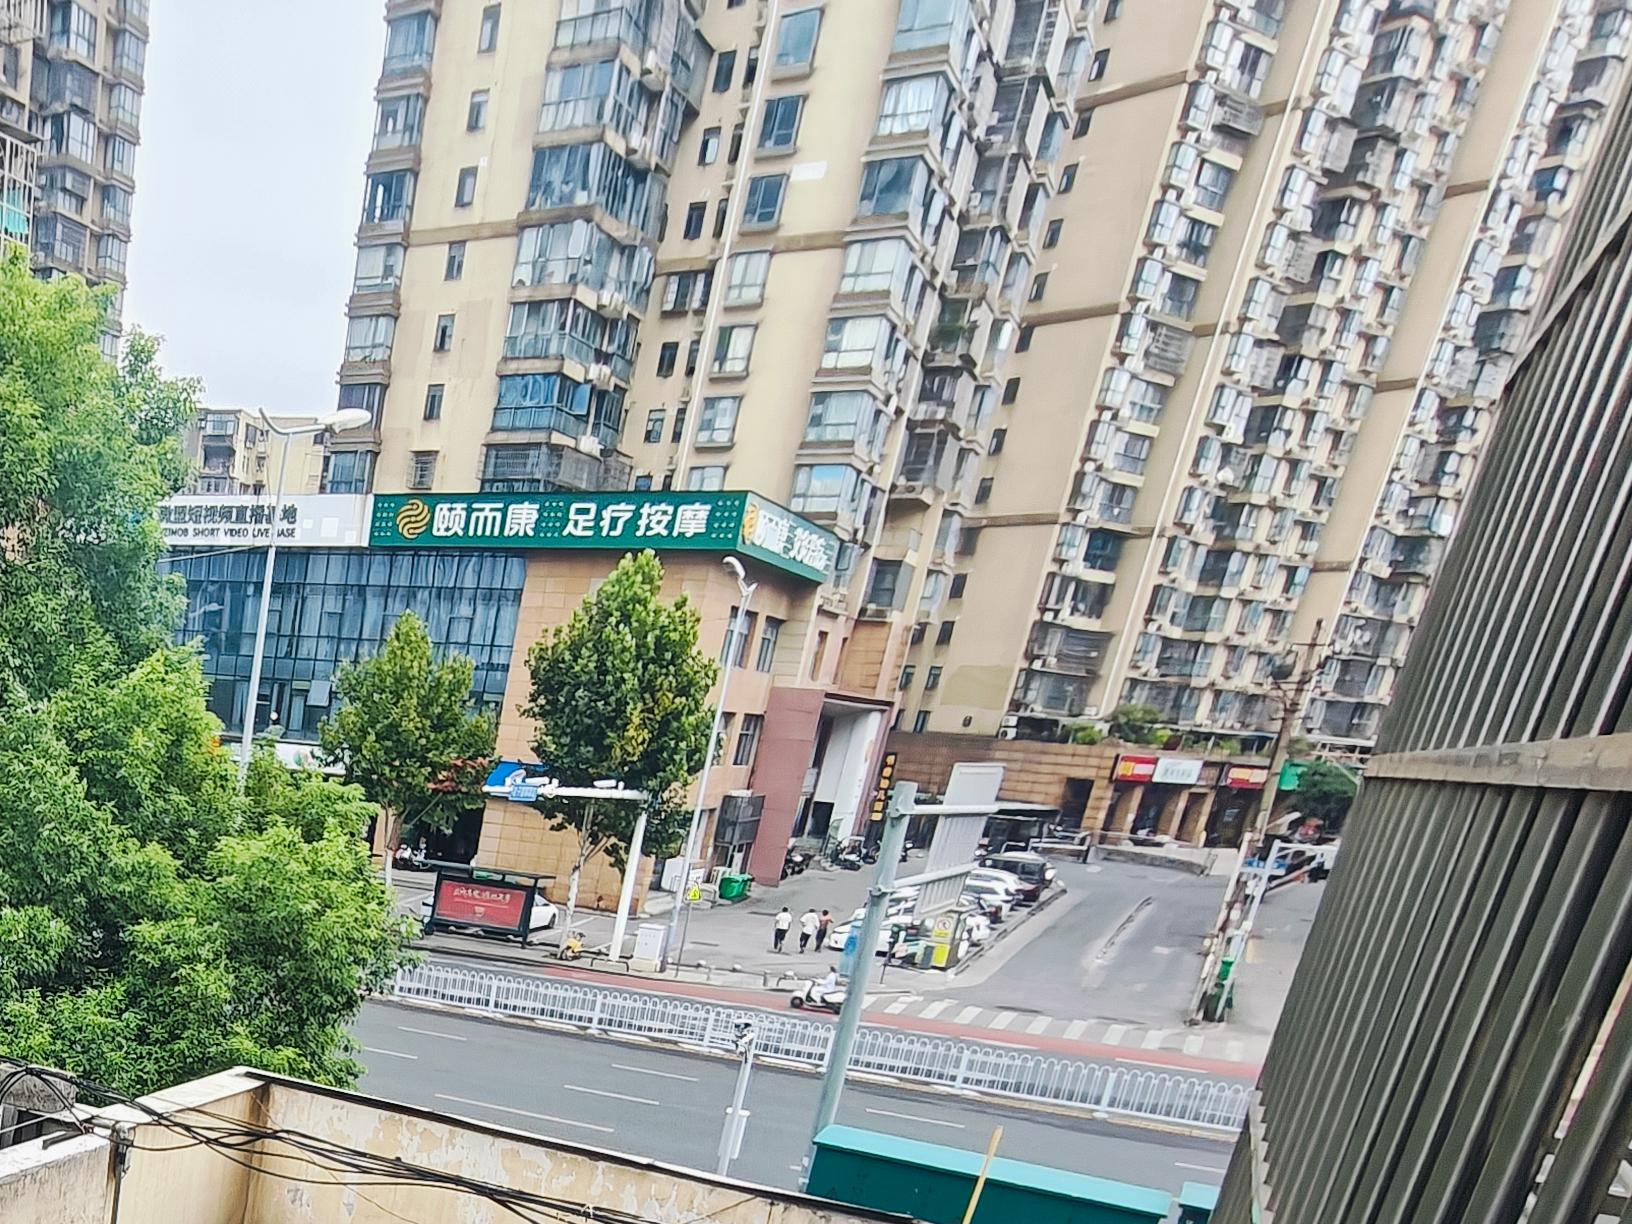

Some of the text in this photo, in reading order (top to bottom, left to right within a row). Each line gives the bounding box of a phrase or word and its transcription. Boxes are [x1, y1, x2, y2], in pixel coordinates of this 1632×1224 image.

[431, 502, 540, 537] 颐而康
[561, 502, 712, 538] 足疗按摩
[192, 527, 220, 537] SHORT
[223, 527, 249, 537] VIDEO
[252, 527, 270, 538] LIVE
